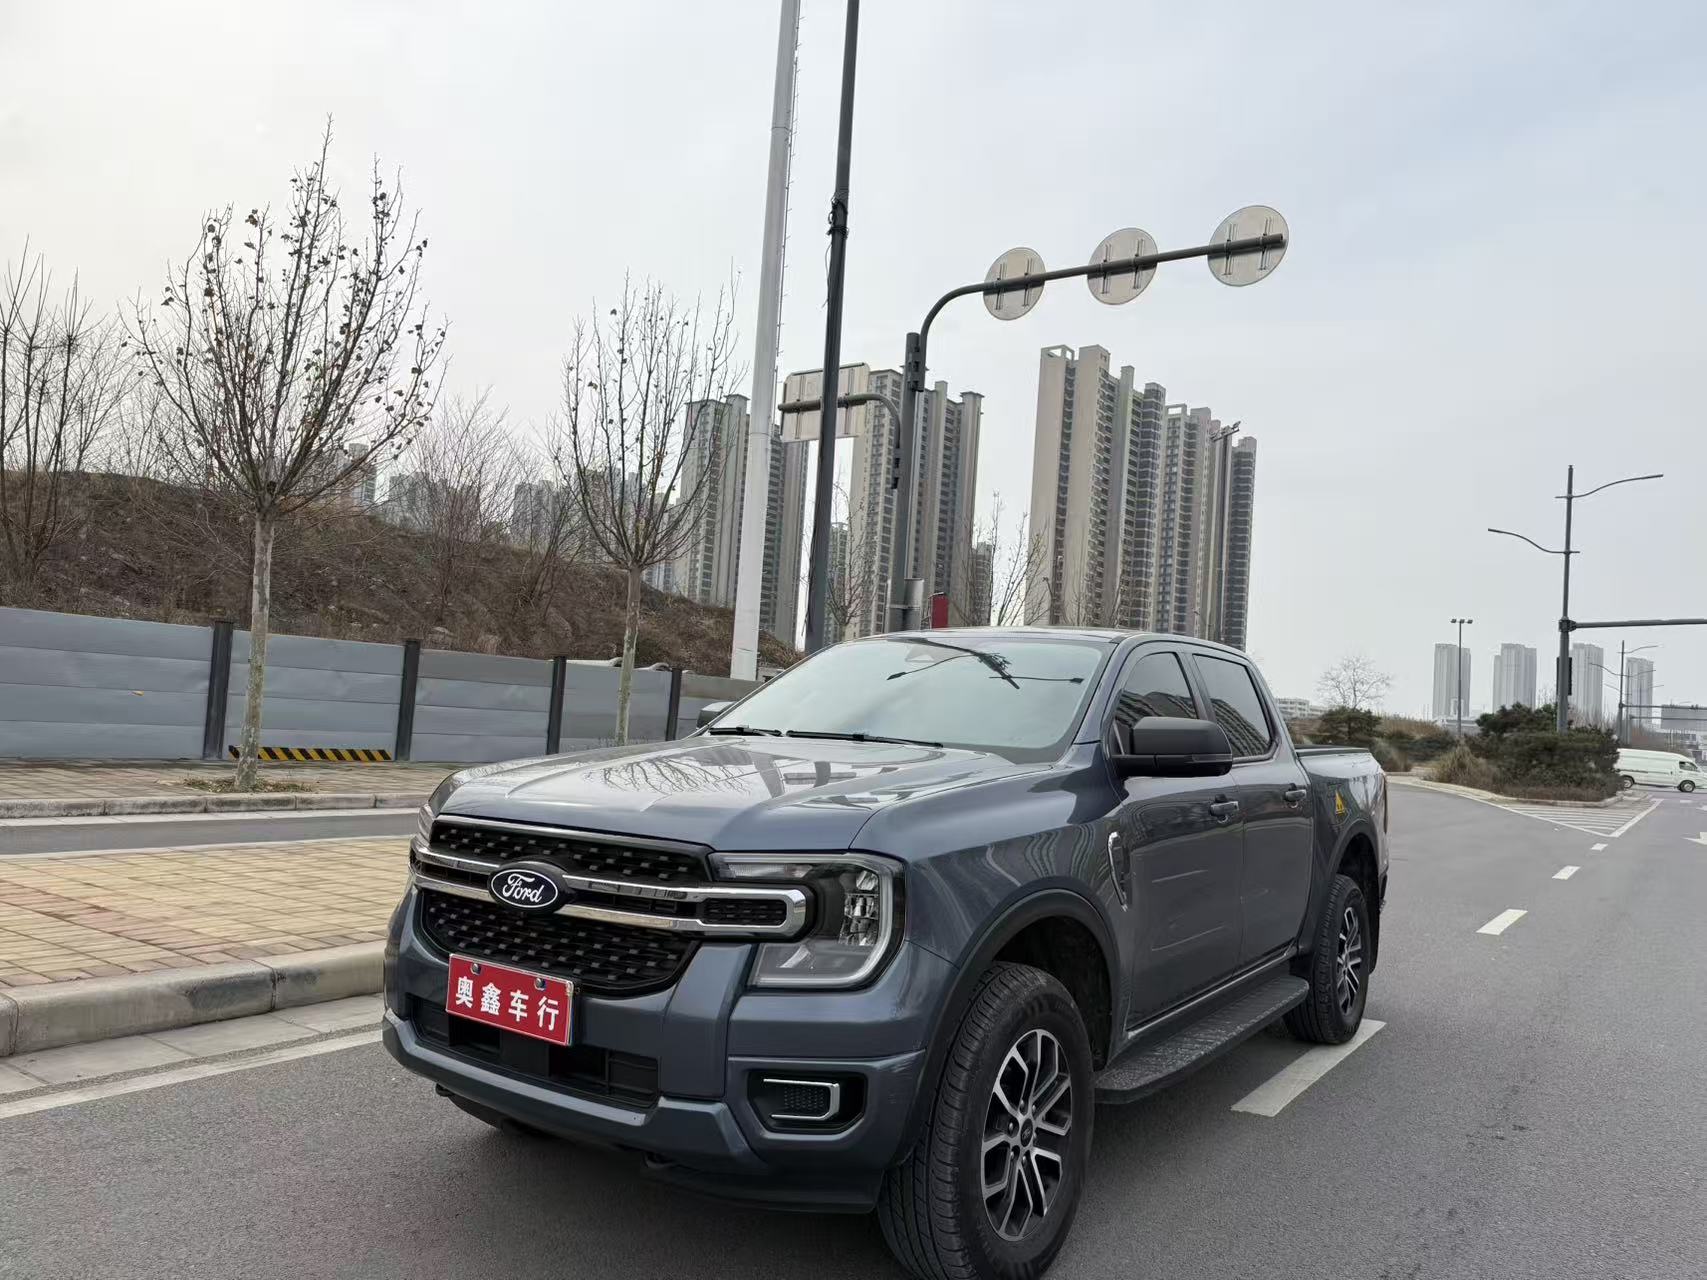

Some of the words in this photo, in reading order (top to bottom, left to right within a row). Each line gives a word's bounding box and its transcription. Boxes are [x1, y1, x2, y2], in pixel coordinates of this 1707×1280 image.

[502, 873, 544, 903] Ford
[455, 976, 559, 1031] 奥鑫车行
